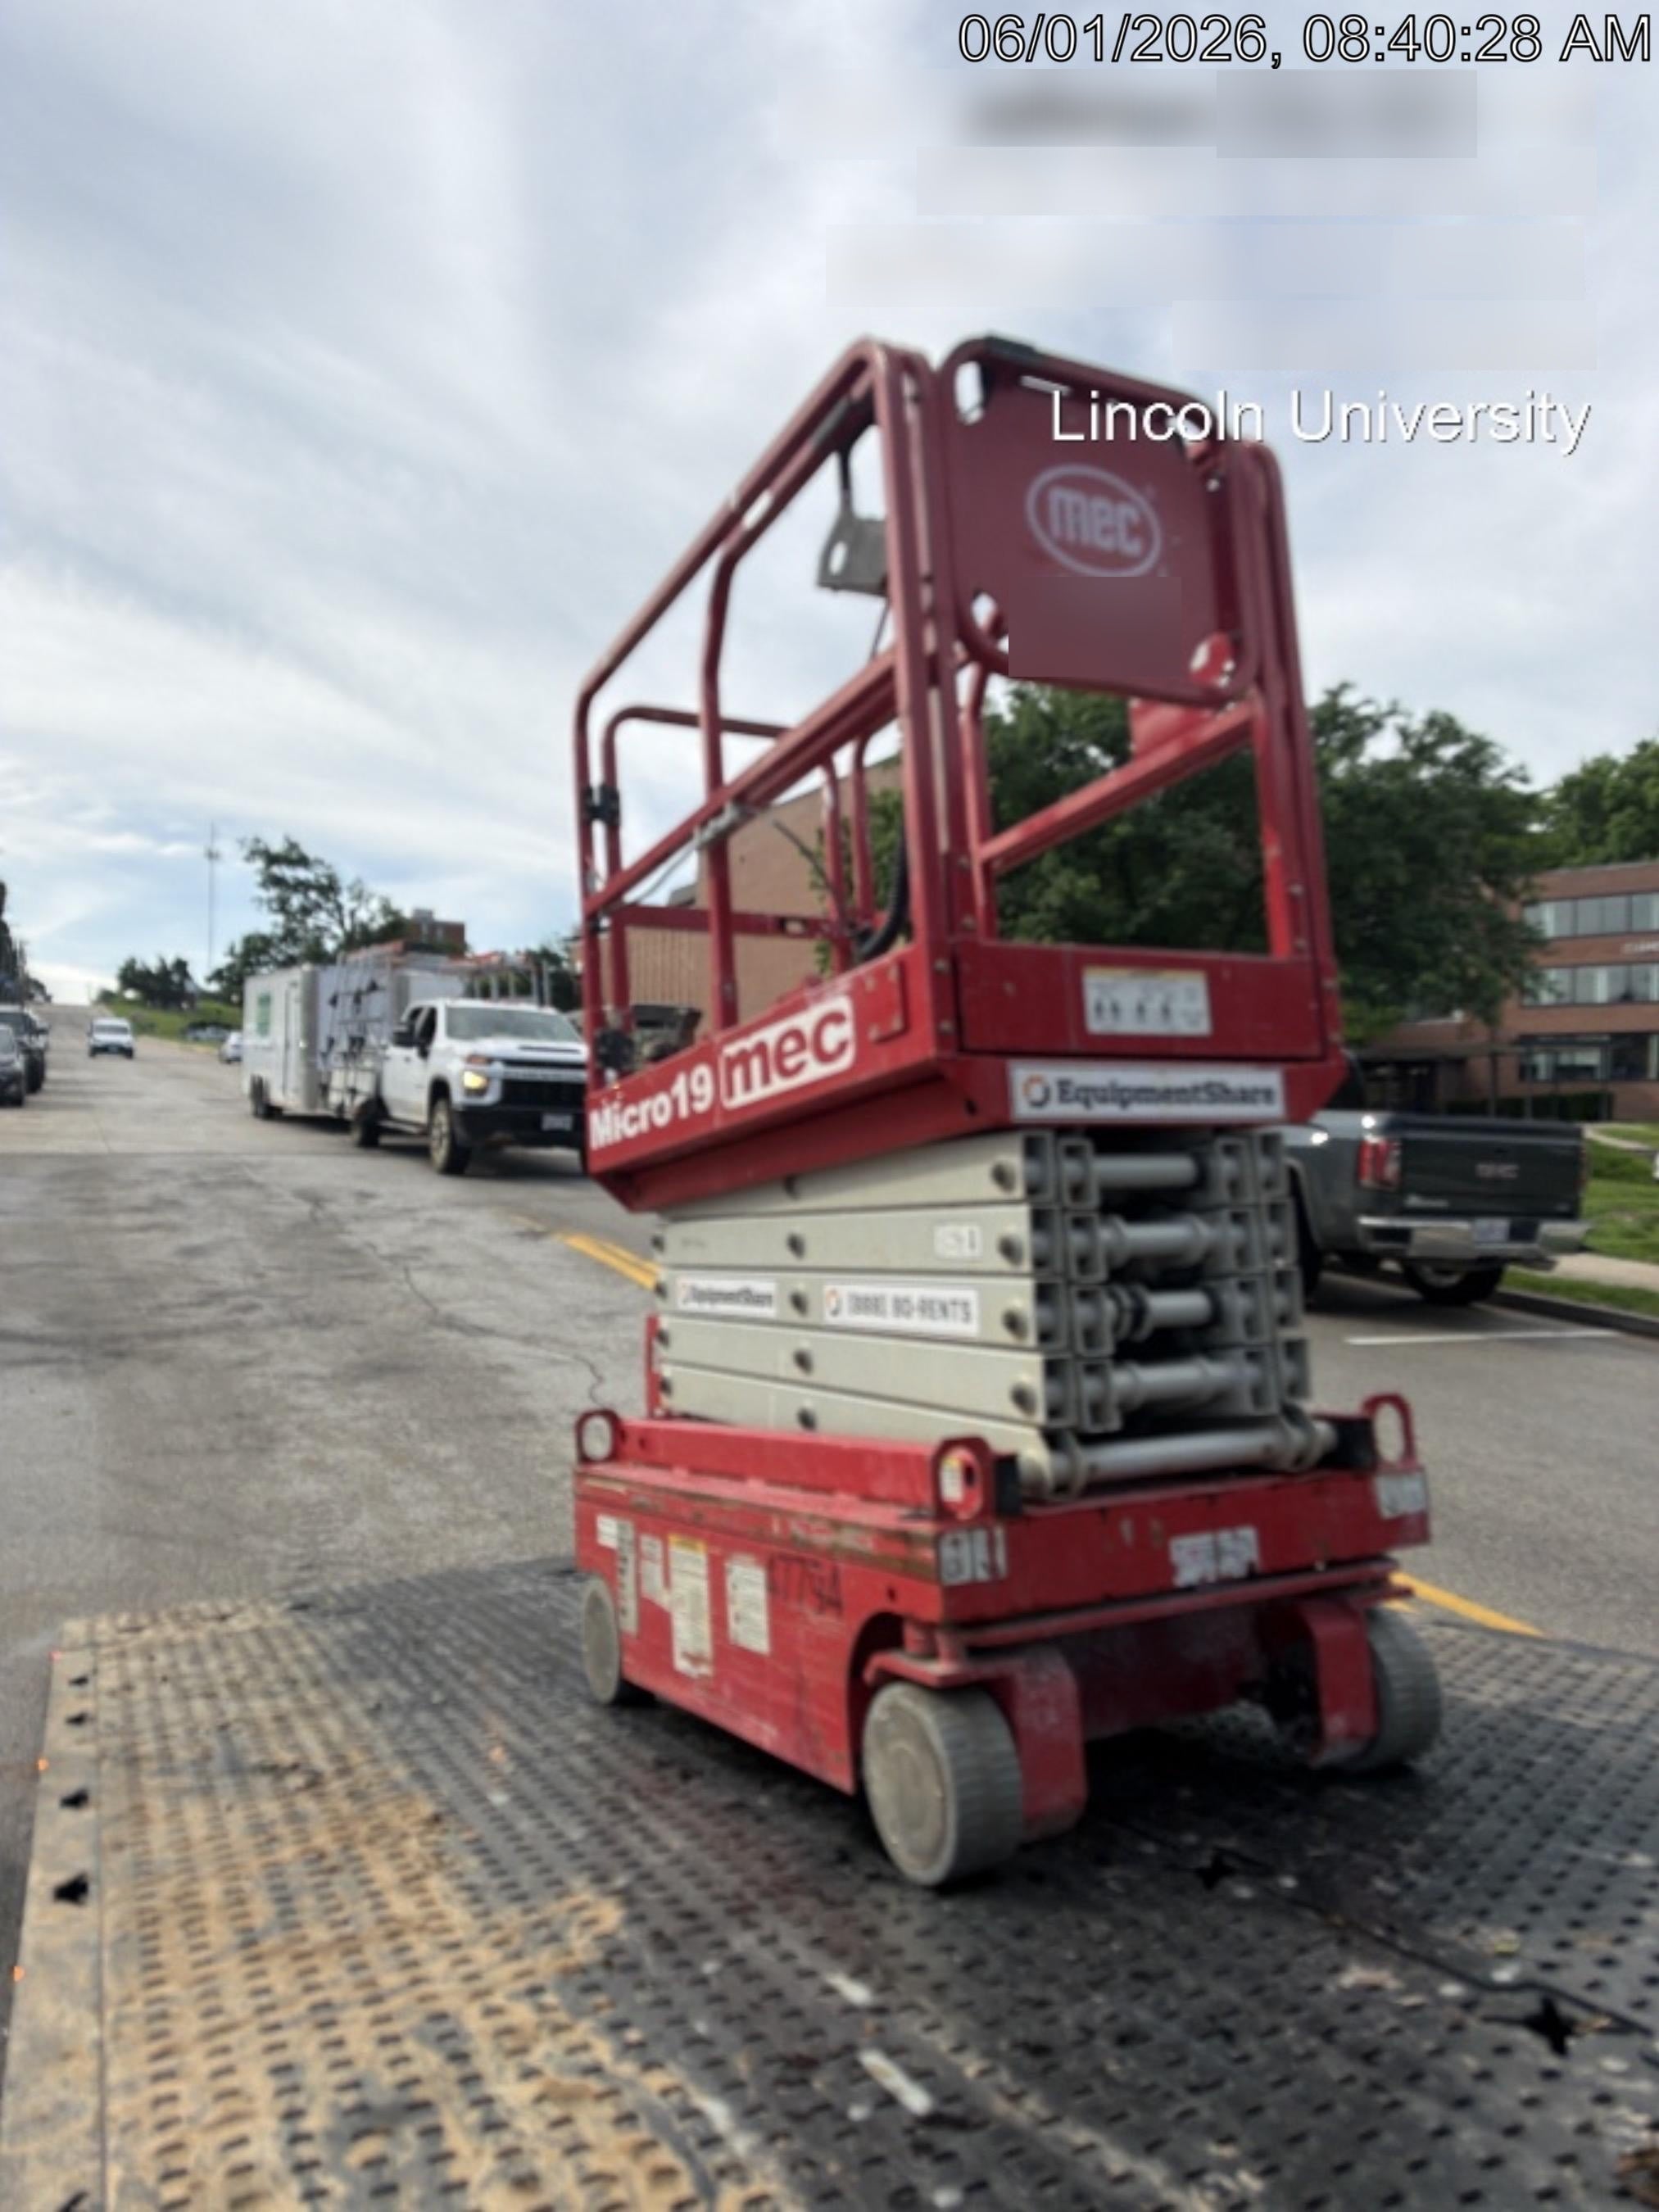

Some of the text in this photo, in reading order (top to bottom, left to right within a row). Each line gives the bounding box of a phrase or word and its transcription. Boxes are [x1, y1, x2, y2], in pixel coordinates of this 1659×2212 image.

[725, 1010, 850, 1103] mec
[1057, 1079, 1275, 1110] EquipmentShare
[589, 1064, 714, 1150] Micro19
